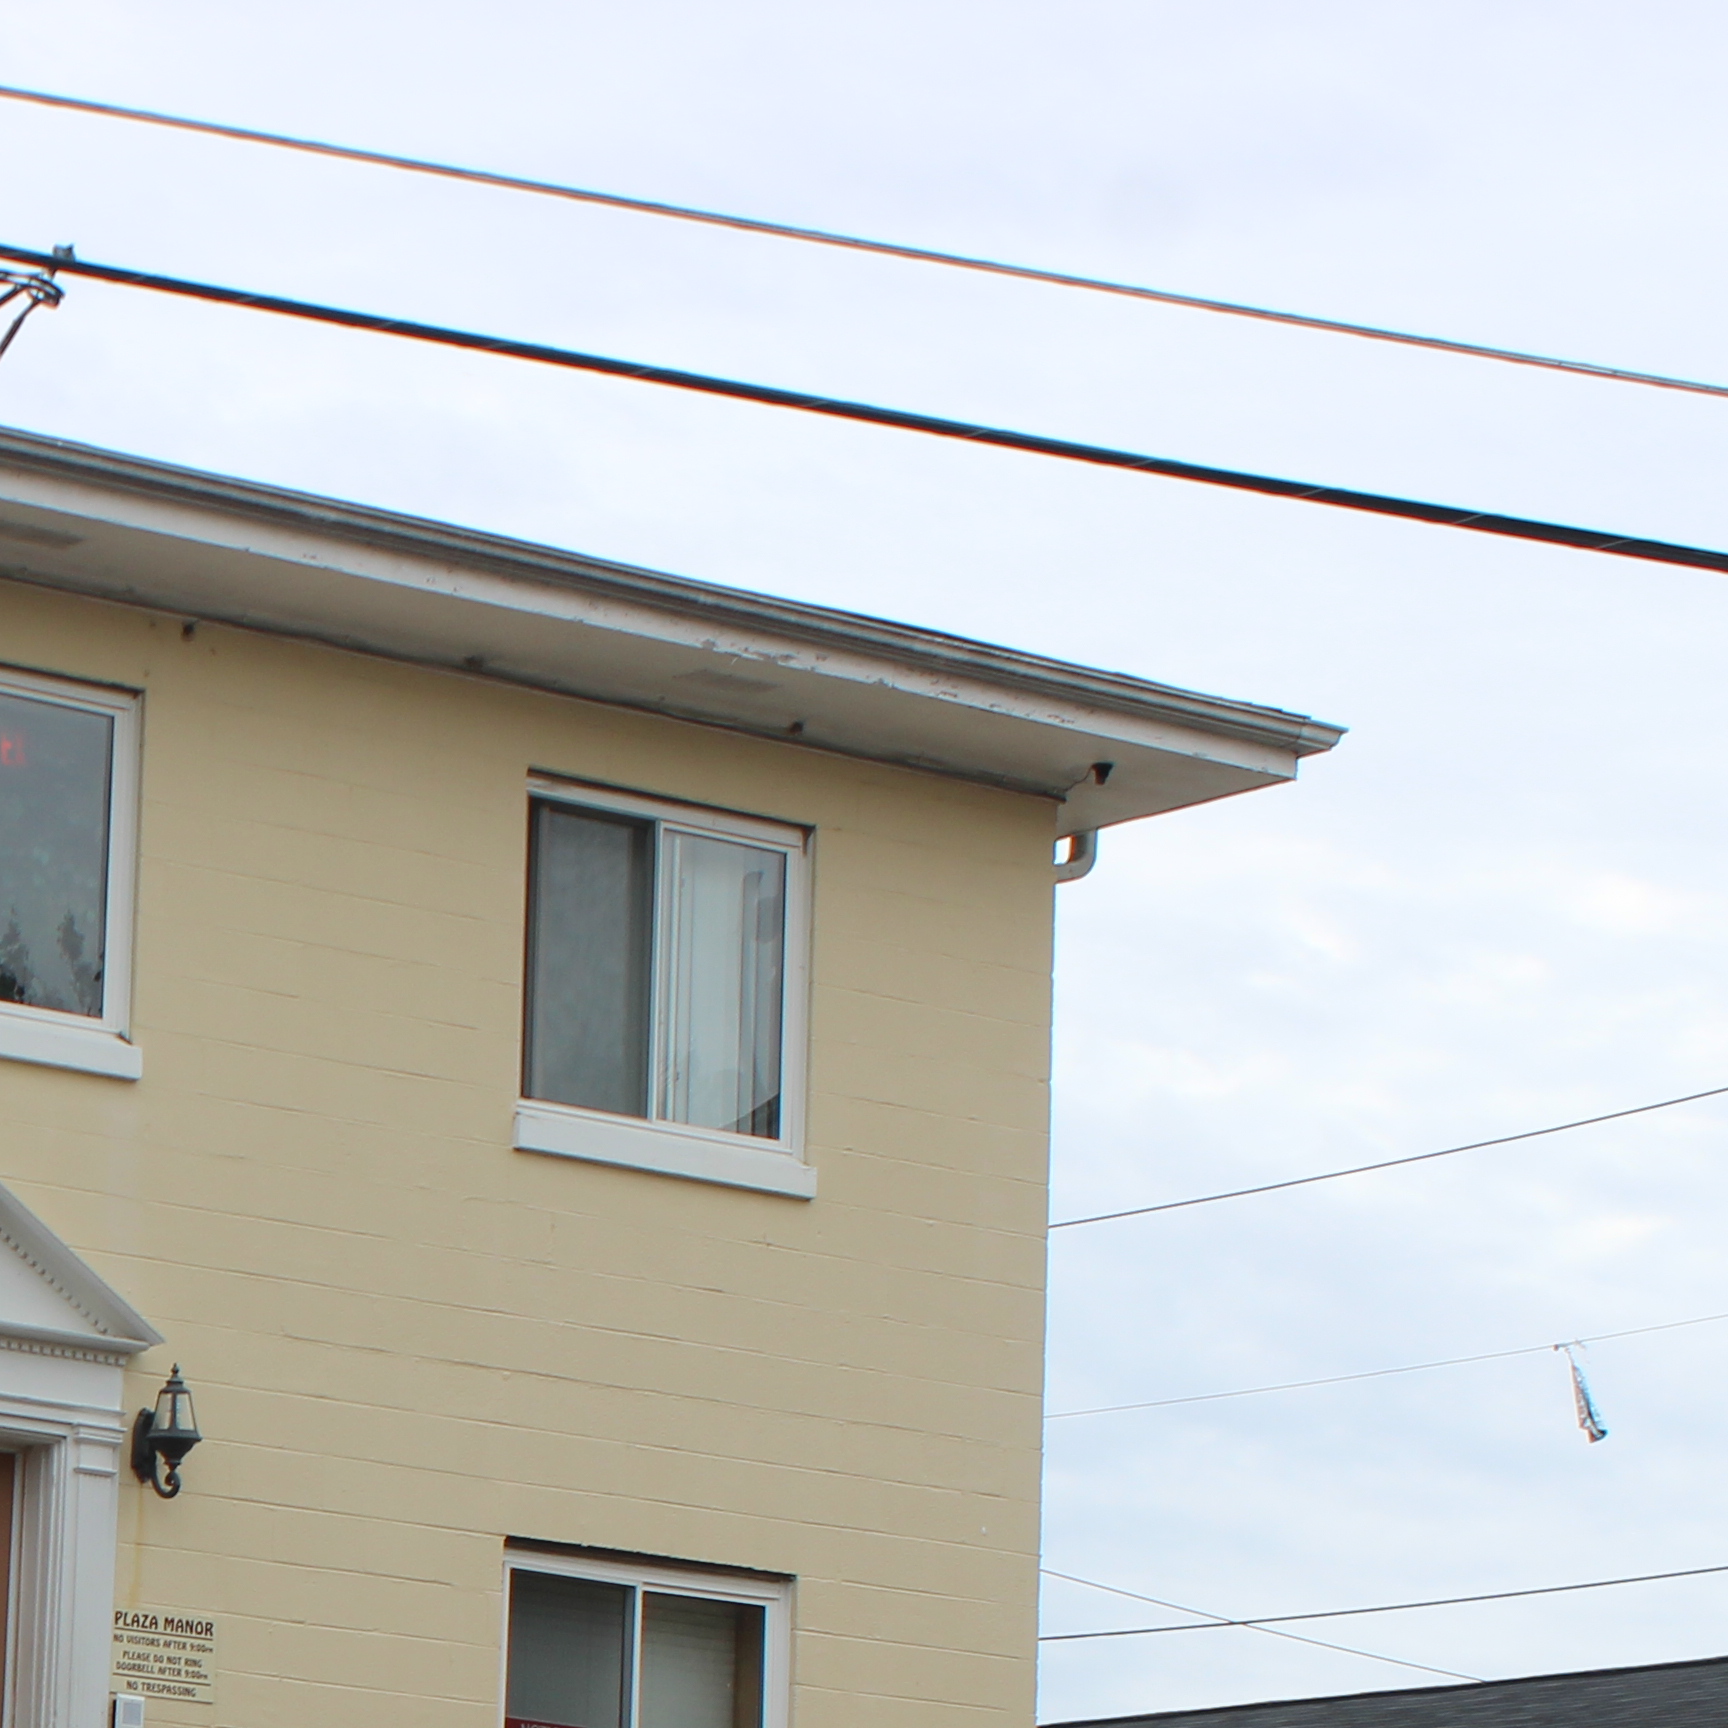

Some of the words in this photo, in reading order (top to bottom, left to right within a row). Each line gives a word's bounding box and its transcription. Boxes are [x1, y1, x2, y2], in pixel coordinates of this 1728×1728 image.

[114, 1610, 159, 1630] PLAZA
[164, 1617, 214, 1637] MANOR
[113, 1634, 124, 1643] NO
[126, 1635, 161, 1648] VISITORS
[163, 1640, 187, 1650] AFTER
[122, 1650, 151, 1661] PLEASE
[153, 1654, 164, 1664] DO
[166, 1655, 182, 1666] NOT
[184, 1658, 202, 1668] RING
[116, 1661, 155, 1674] DOORBELL
[157, 1667, 182, 1678] AFTER
[126, 1680, 138, 1691] NO
[141, 1682, 196, 1698] TRESPASSING
